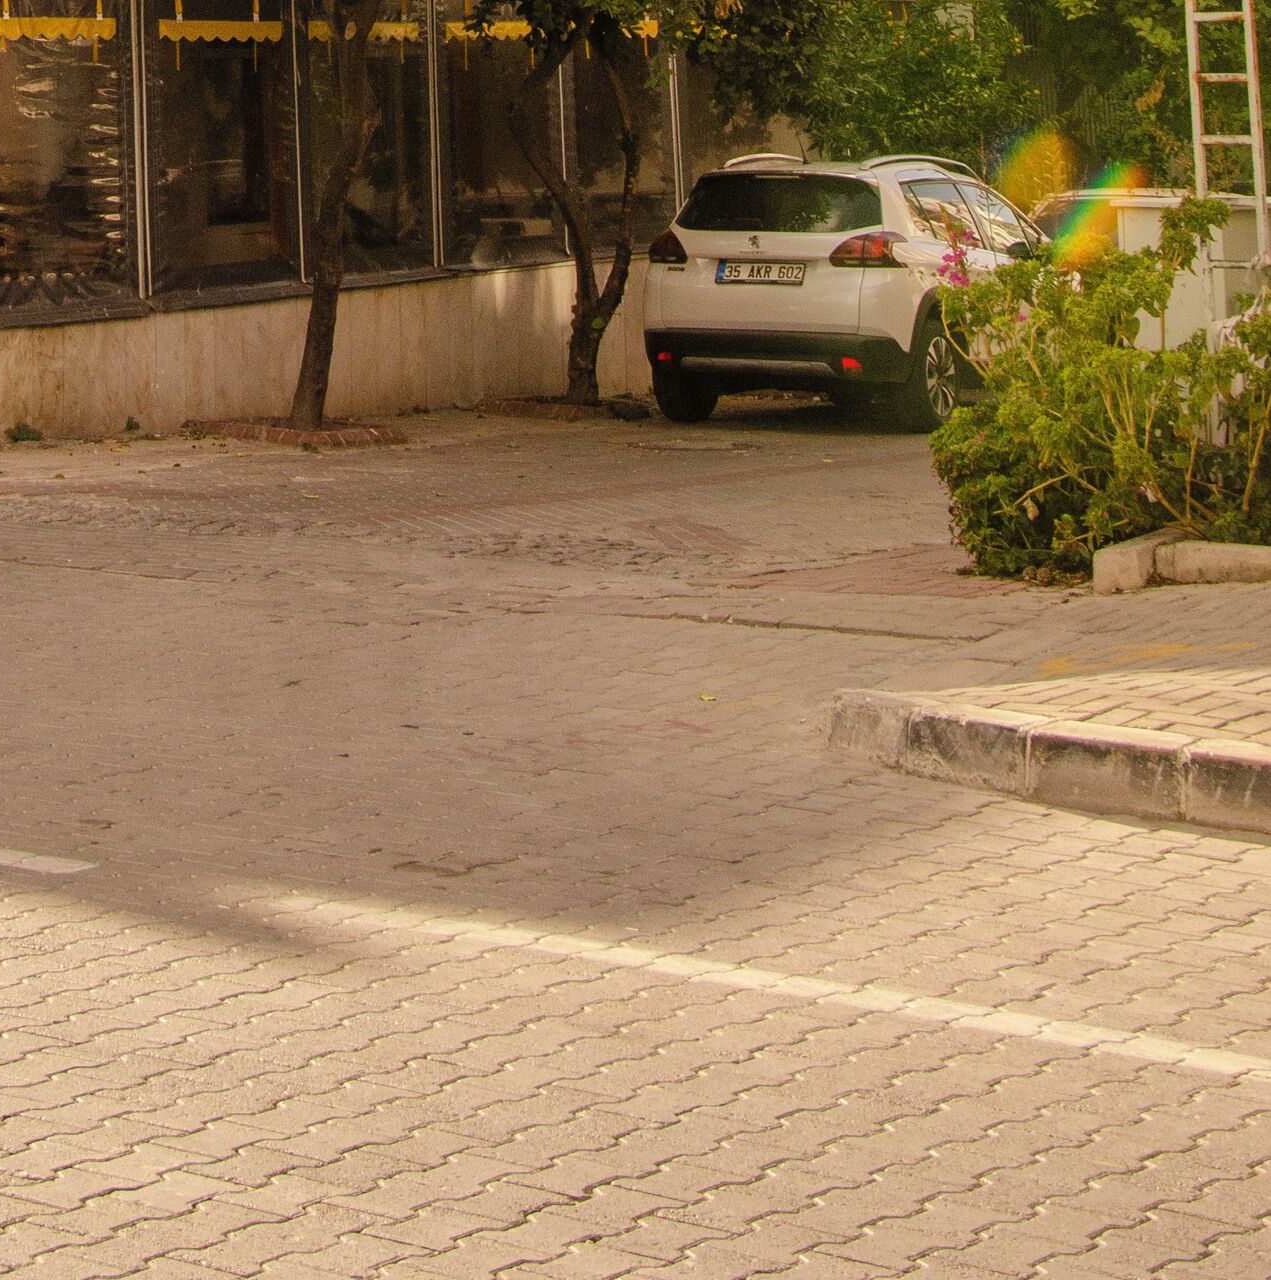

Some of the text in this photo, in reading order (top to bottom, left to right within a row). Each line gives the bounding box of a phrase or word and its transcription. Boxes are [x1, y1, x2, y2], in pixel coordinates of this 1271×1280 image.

[725, 265, 802, 280] 35 AKR 602
